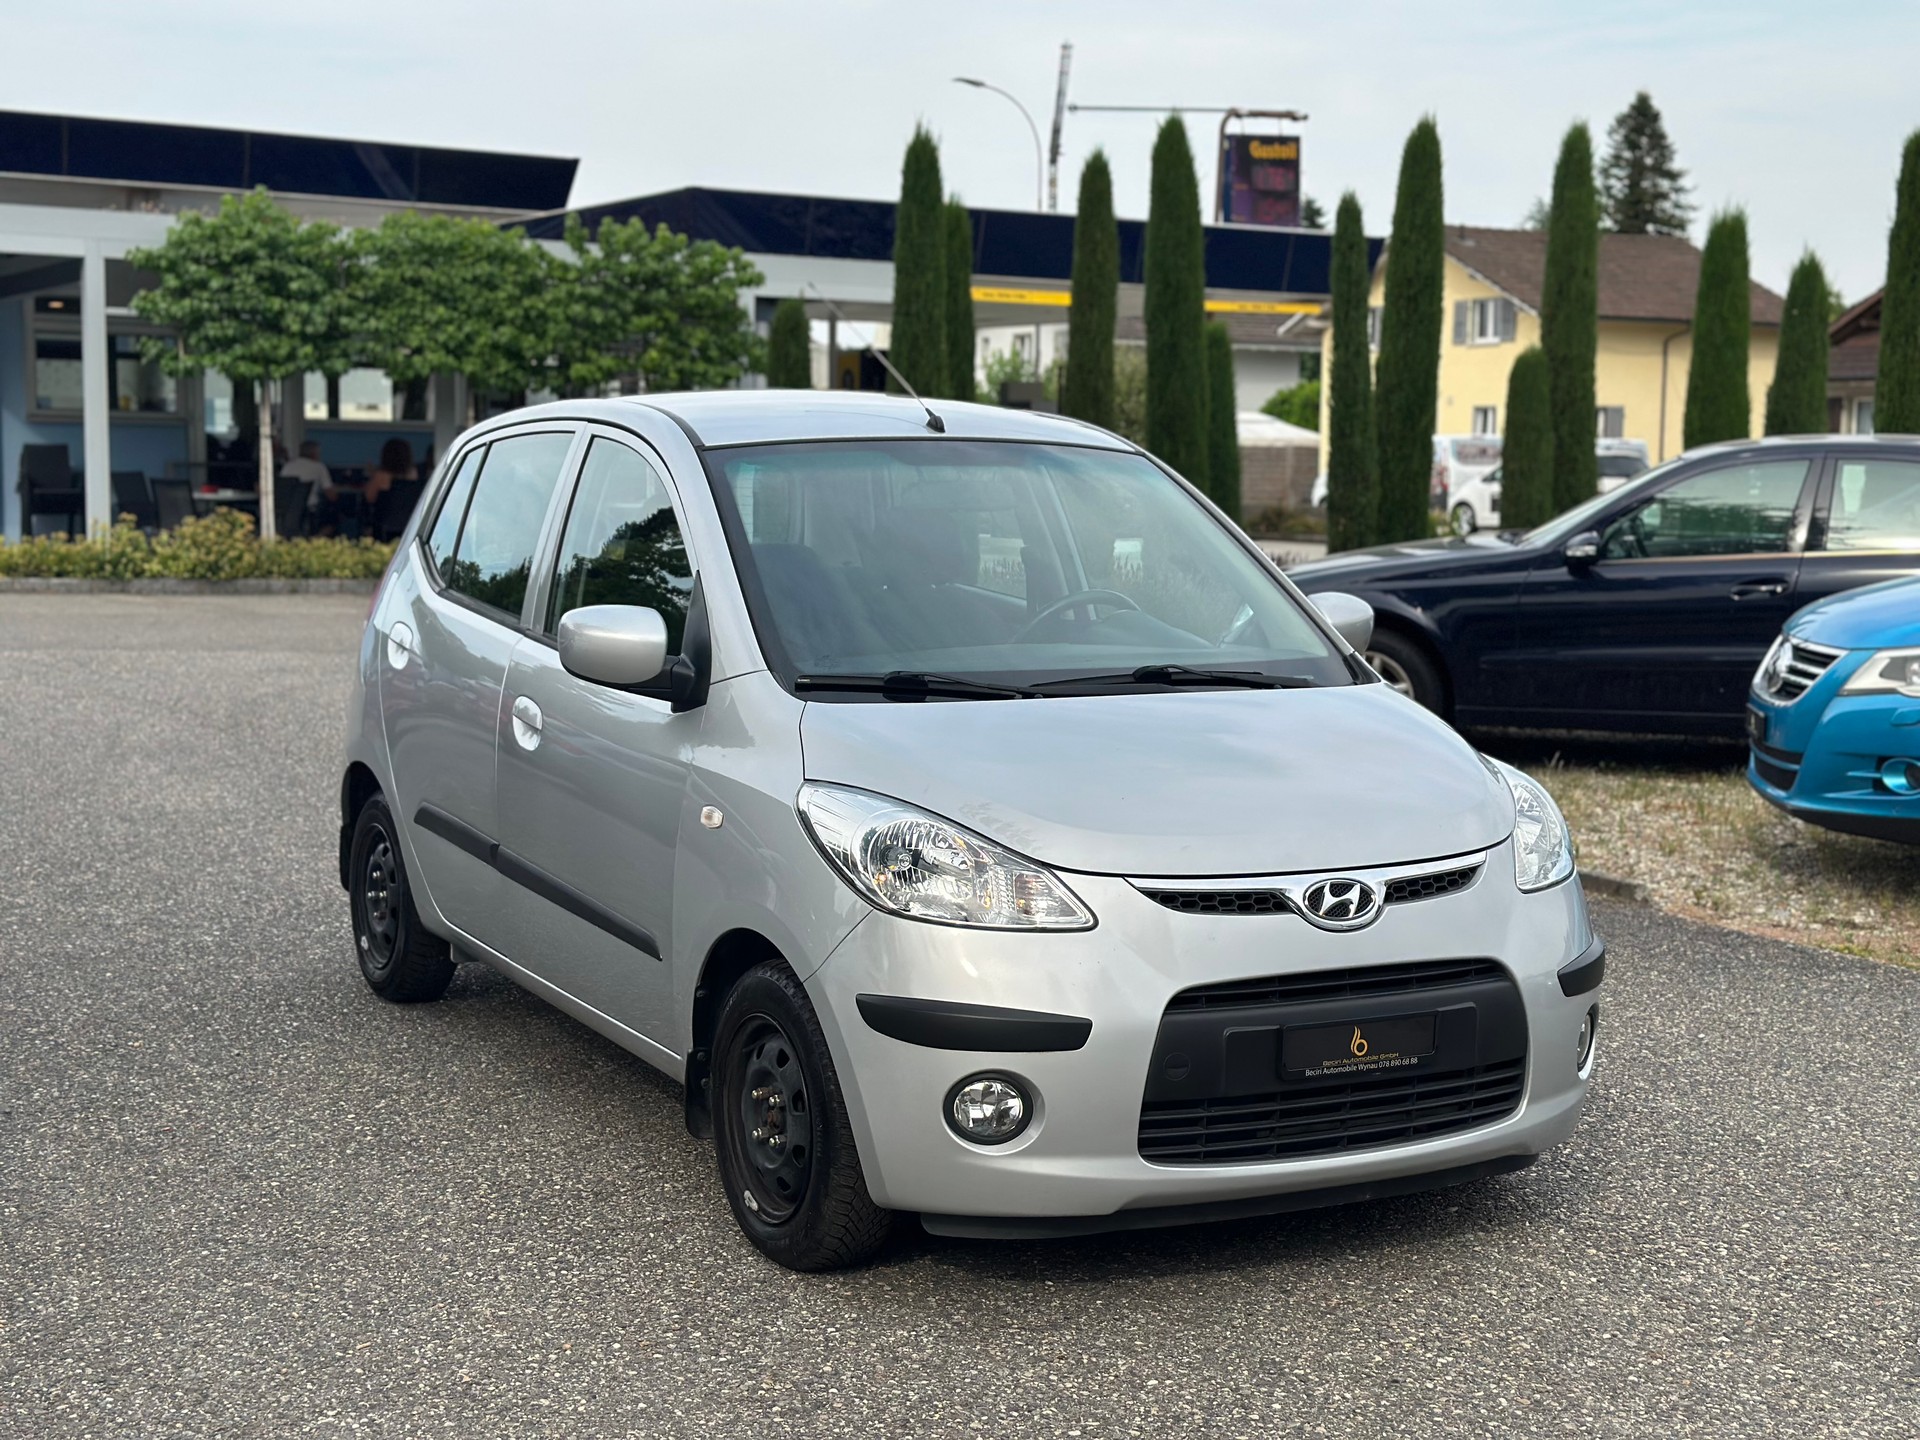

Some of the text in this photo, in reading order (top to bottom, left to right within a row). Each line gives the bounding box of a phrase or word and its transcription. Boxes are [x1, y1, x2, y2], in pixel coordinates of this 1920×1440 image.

[1322, 1064, 1358, 1075] Automobile
[1358, 1062, 1378, 1072] Wynau
[1378, 1060, 1390, 1069] 078
